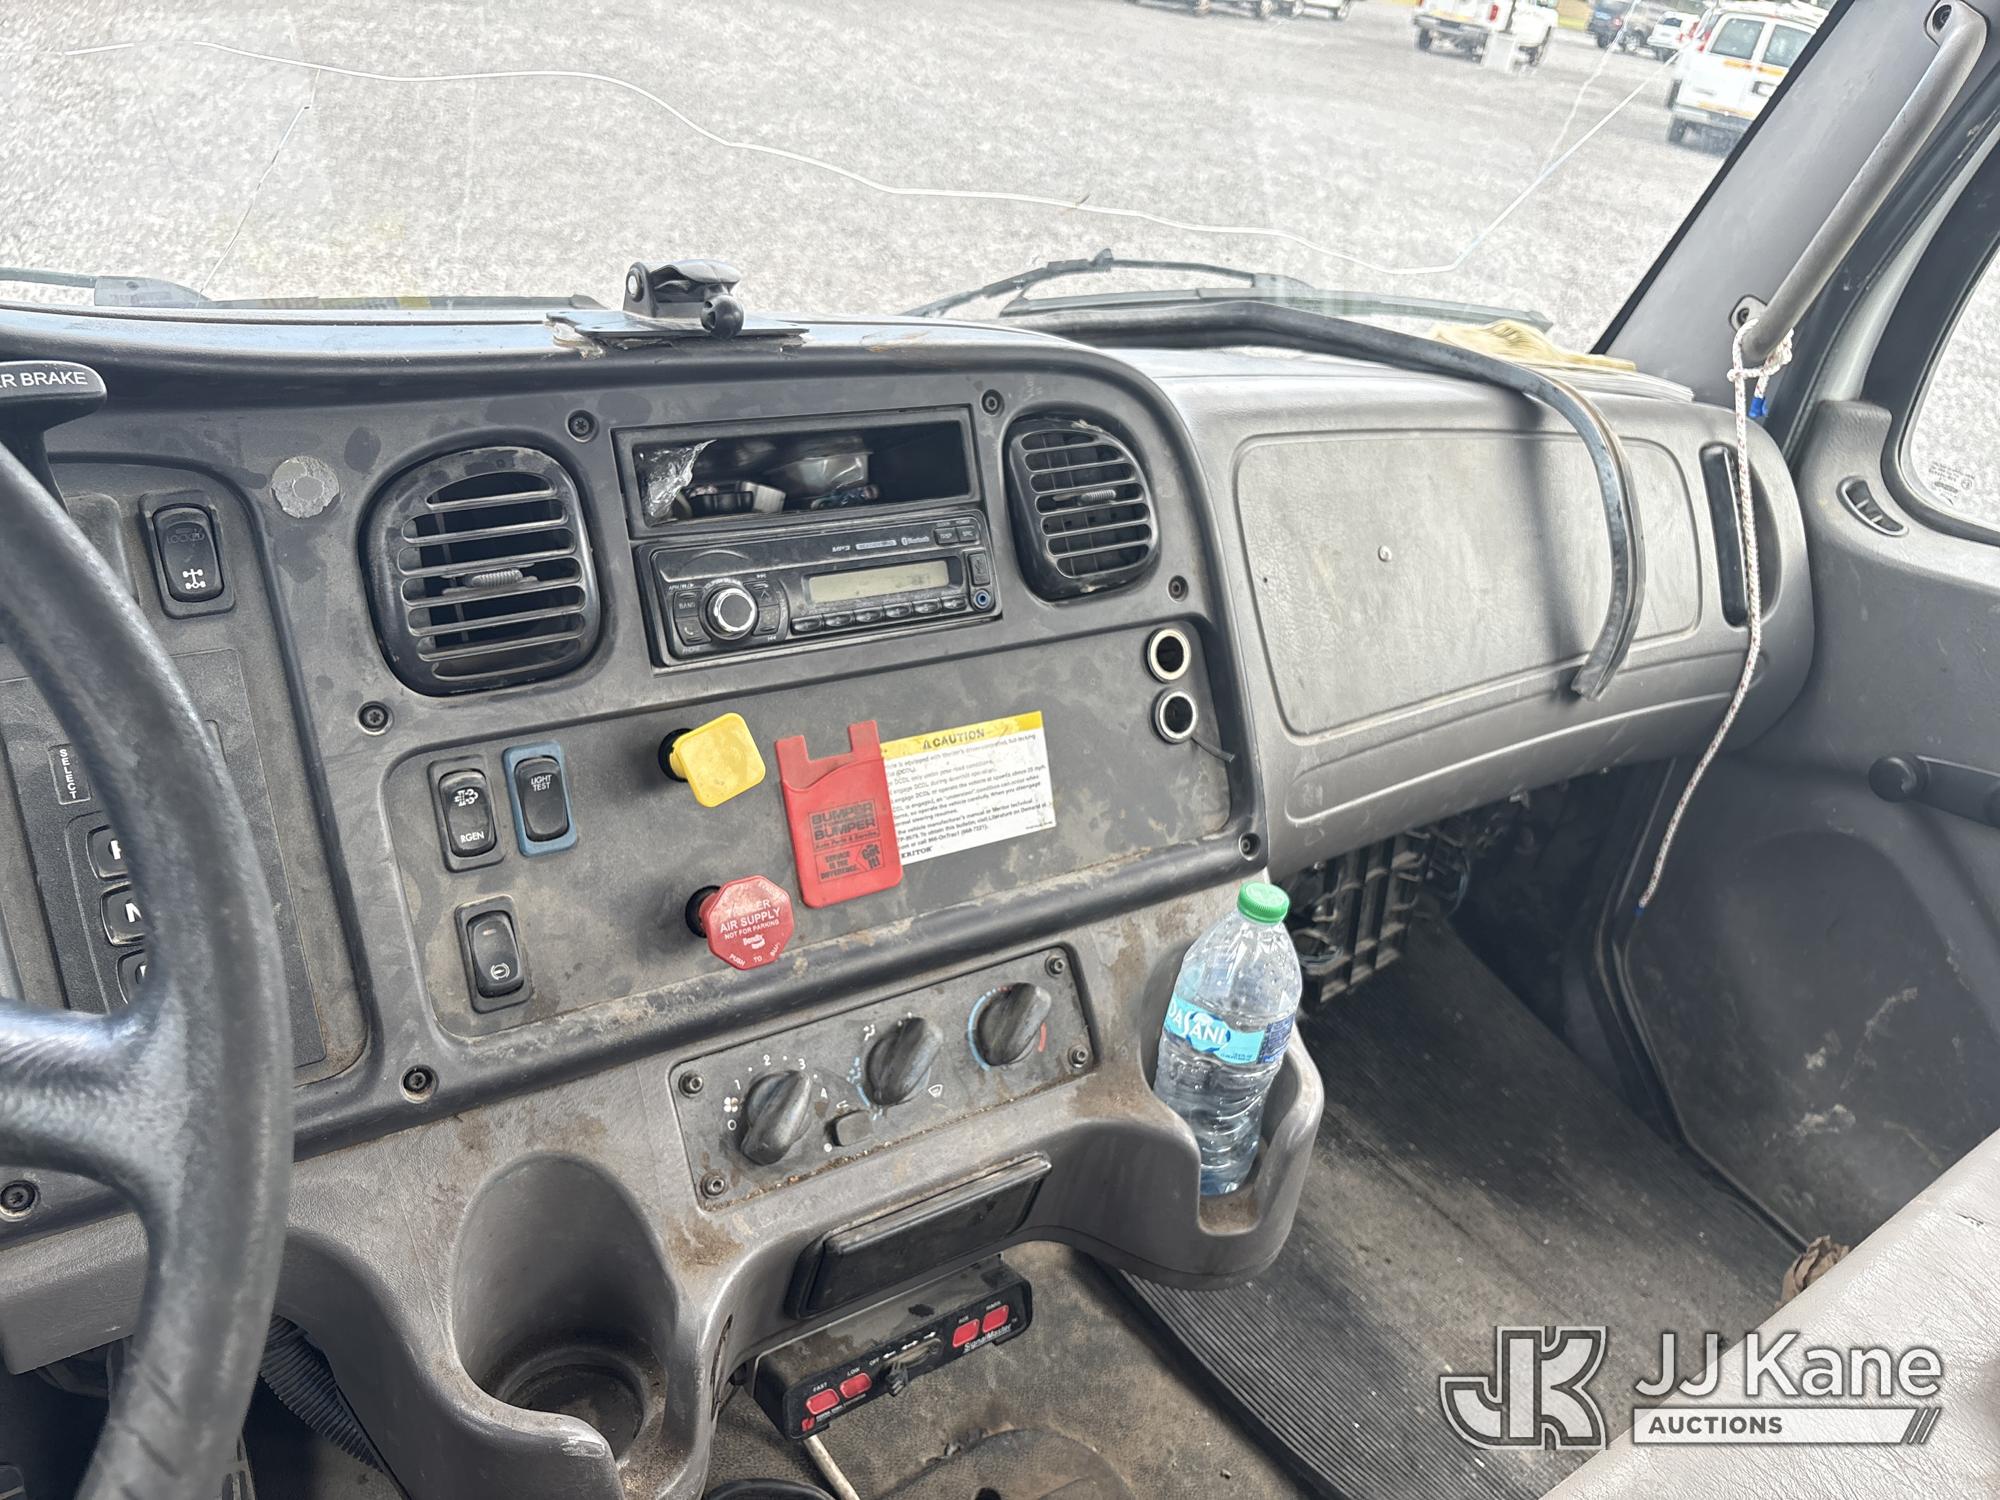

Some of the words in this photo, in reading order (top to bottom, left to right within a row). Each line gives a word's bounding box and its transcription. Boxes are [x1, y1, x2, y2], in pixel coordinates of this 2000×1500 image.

[0, 373, 17, 388] R
[20, 371, 88, 386] BRAKE
[931, 727, 984, 748] CAUTION
[903, 756, 929, 766] equipped
[59, 748, 76, 799] SELECT
[893, 776, 909, 785] DCDL
[910, 773, 922, 781] only
[530, 774, 552, 786] LIGHT
[893, 785, 912, 795] engage
[930, 777, 947, 786] during
[533, 782, 551, 792] TEST
[894, 793, 914, 803] engage
[937, 783, 957, 793] operate
[958, 781, 967, 789] the
[967, 777, 986, 786] vehicle
[917, 804, 938, 814] operate
[947, 798, 966, 807] vehicle
[990, 789, 1004, 797] When
[812, 802, 873, 824] BUMPER
[911, 814, 934, 824] steering
[907, 824, 926, 832] vehicle
[966, 810, 984, 818] manual
[815, 819, 875, 840] BUMPER
[927, 827, 944, 835] obtain
[460, 831, 485, 843] RGEN
[720, 920, 738, 933] AIR
[740, 907, 780, 927] SUPPLY
[724, 930, 738, 940] NOT
[739, 926, 752, 936] FOR
[753, 919, 780, 931] PARKING
[729, 954, 746, 967] PUSH
[753, 955, 762, 963] TO
[1168, 998, 1226, 1046] DASANI
[763, 1054, 772, 1066] 2
[798, 1058, 806, 1070] 3
[734, 1079, 741, 1090] 1
[868, 1356, 880, 1366] OFF
[847, 1366, 861, 1377] LOW
[812, 1382, 828, 1393] FAST
